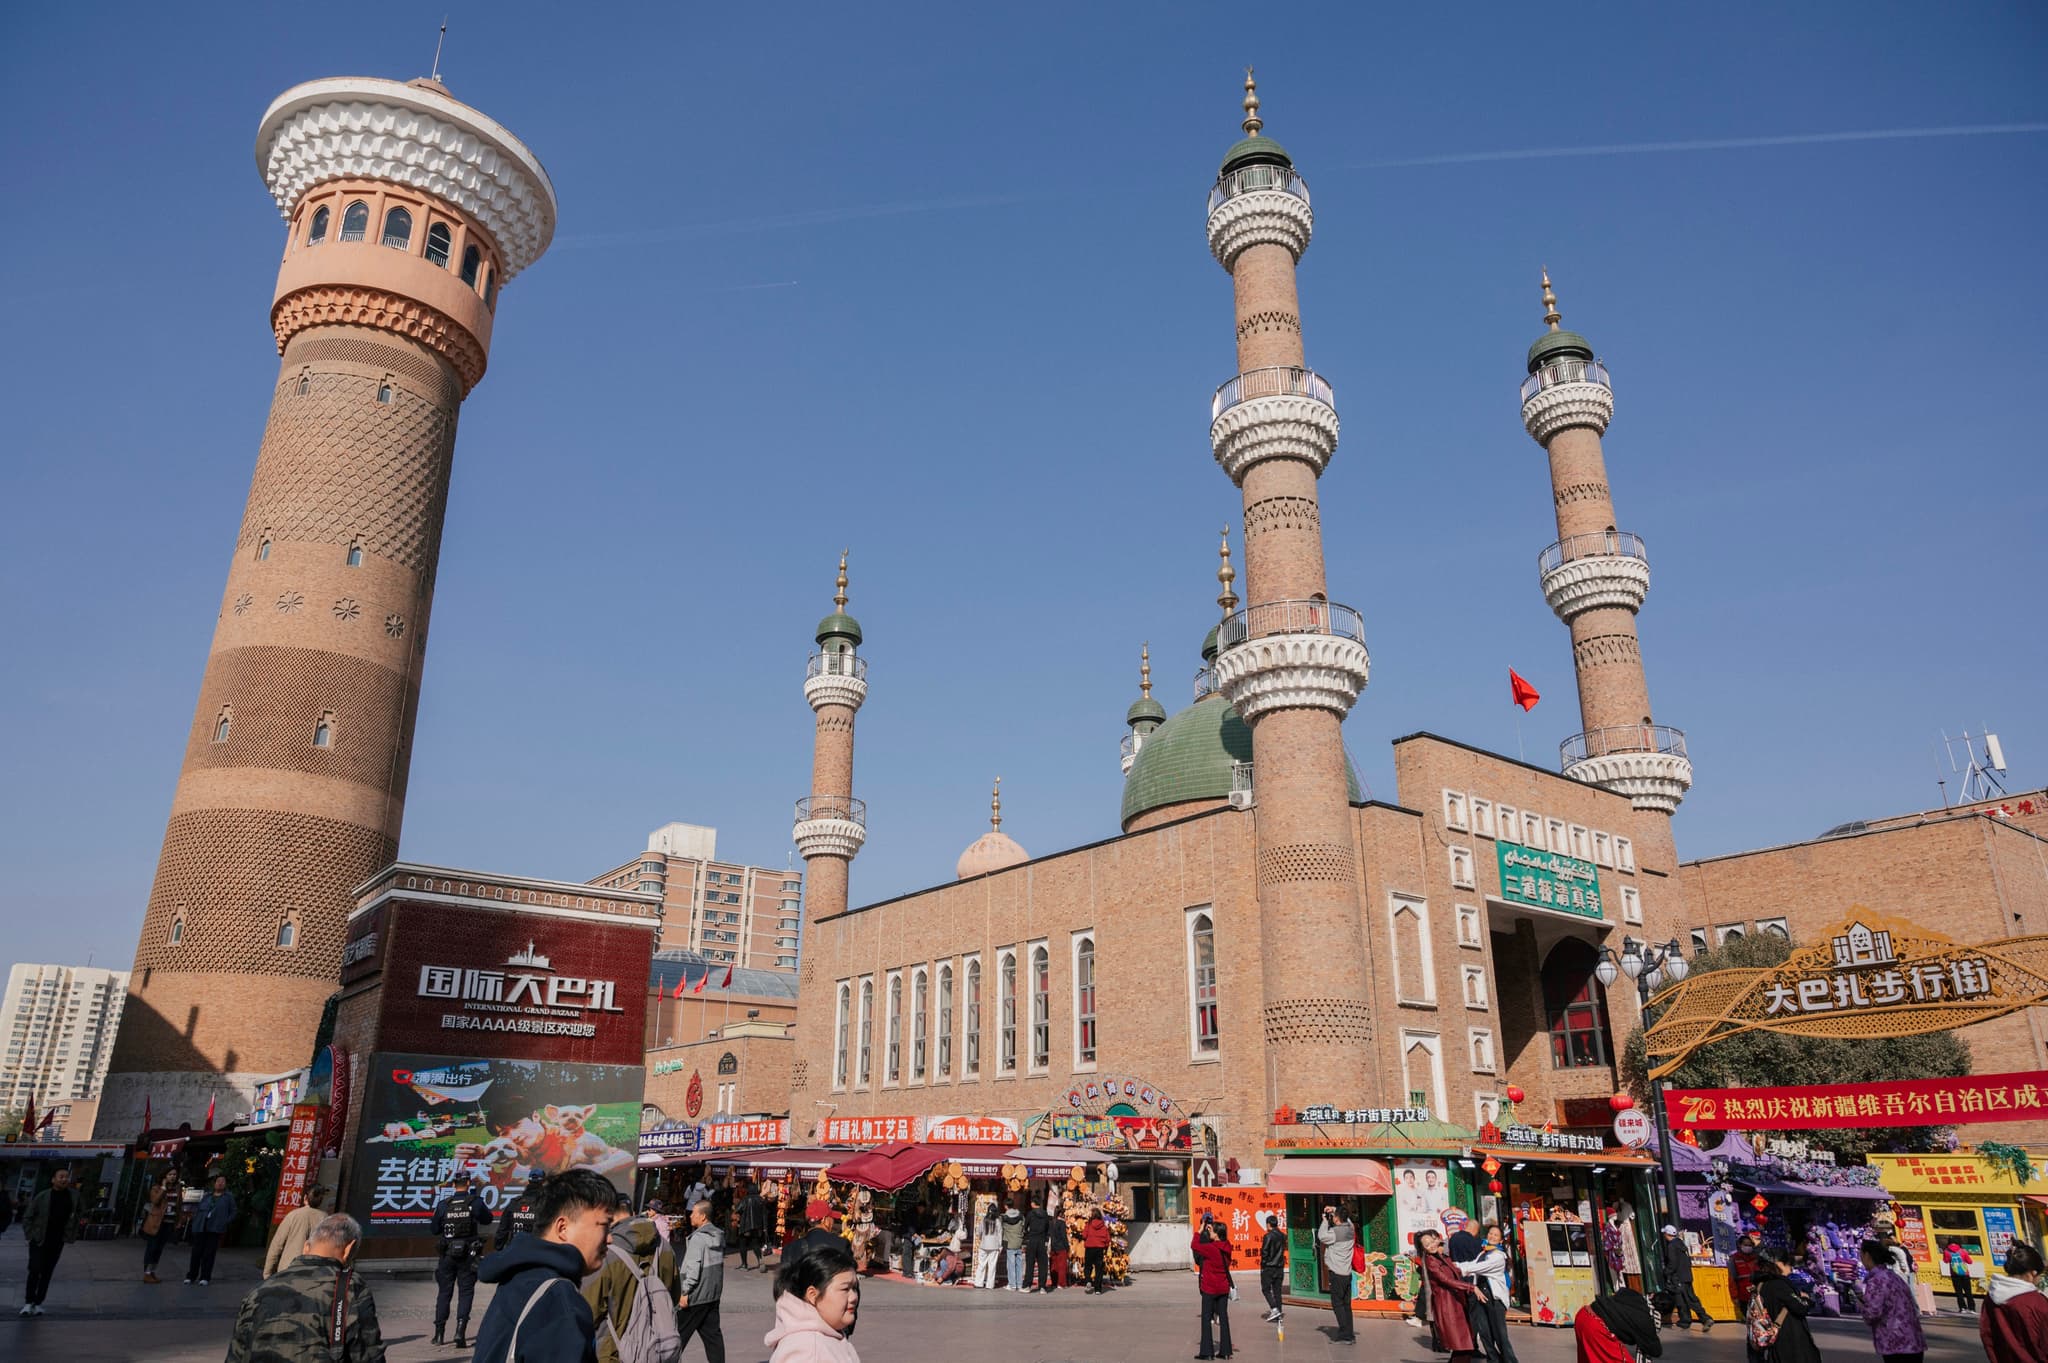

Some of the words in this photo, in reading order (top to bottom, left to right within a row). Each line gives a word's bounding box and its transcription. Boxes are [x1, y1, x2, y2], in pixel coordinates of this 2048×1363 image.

[417, 964, 625, 1012] 国际大巴扎
[1766, 959, 1991, 1014] 大巴扎步行街
[464, 1002, 522, 1013] INTERNATIONAL
[525, 1006, 550, 1015] GRAND
[551, 1008, 580, 1018] BAZAAR
[442, 1014, 596, 1037] 国家AAAA级景区欢迎您
[1345, 1108, 1429, 1123] 步行街官方文创
[715, 1122, 777, 1144] 新疆礼物工艺品
[829, 1118, 908, 1141] 新疆礼物工艺品
[933, 1124, 1013, 1142] 新疆礼物工艺品
[278, 1120, 304, 1206] 国际大巴扎
[291, 1120, 316, 1206] 演艺售票处
[378, 1157, 492, 1182] 去往秋天
[372, 1185, 526, 1211] 天天减0元
[1232, 1208, 1251, 1232] 新
[1234, 1233, 1250, 1241] XIN
[334, 1326, 342, 1341] EOS
